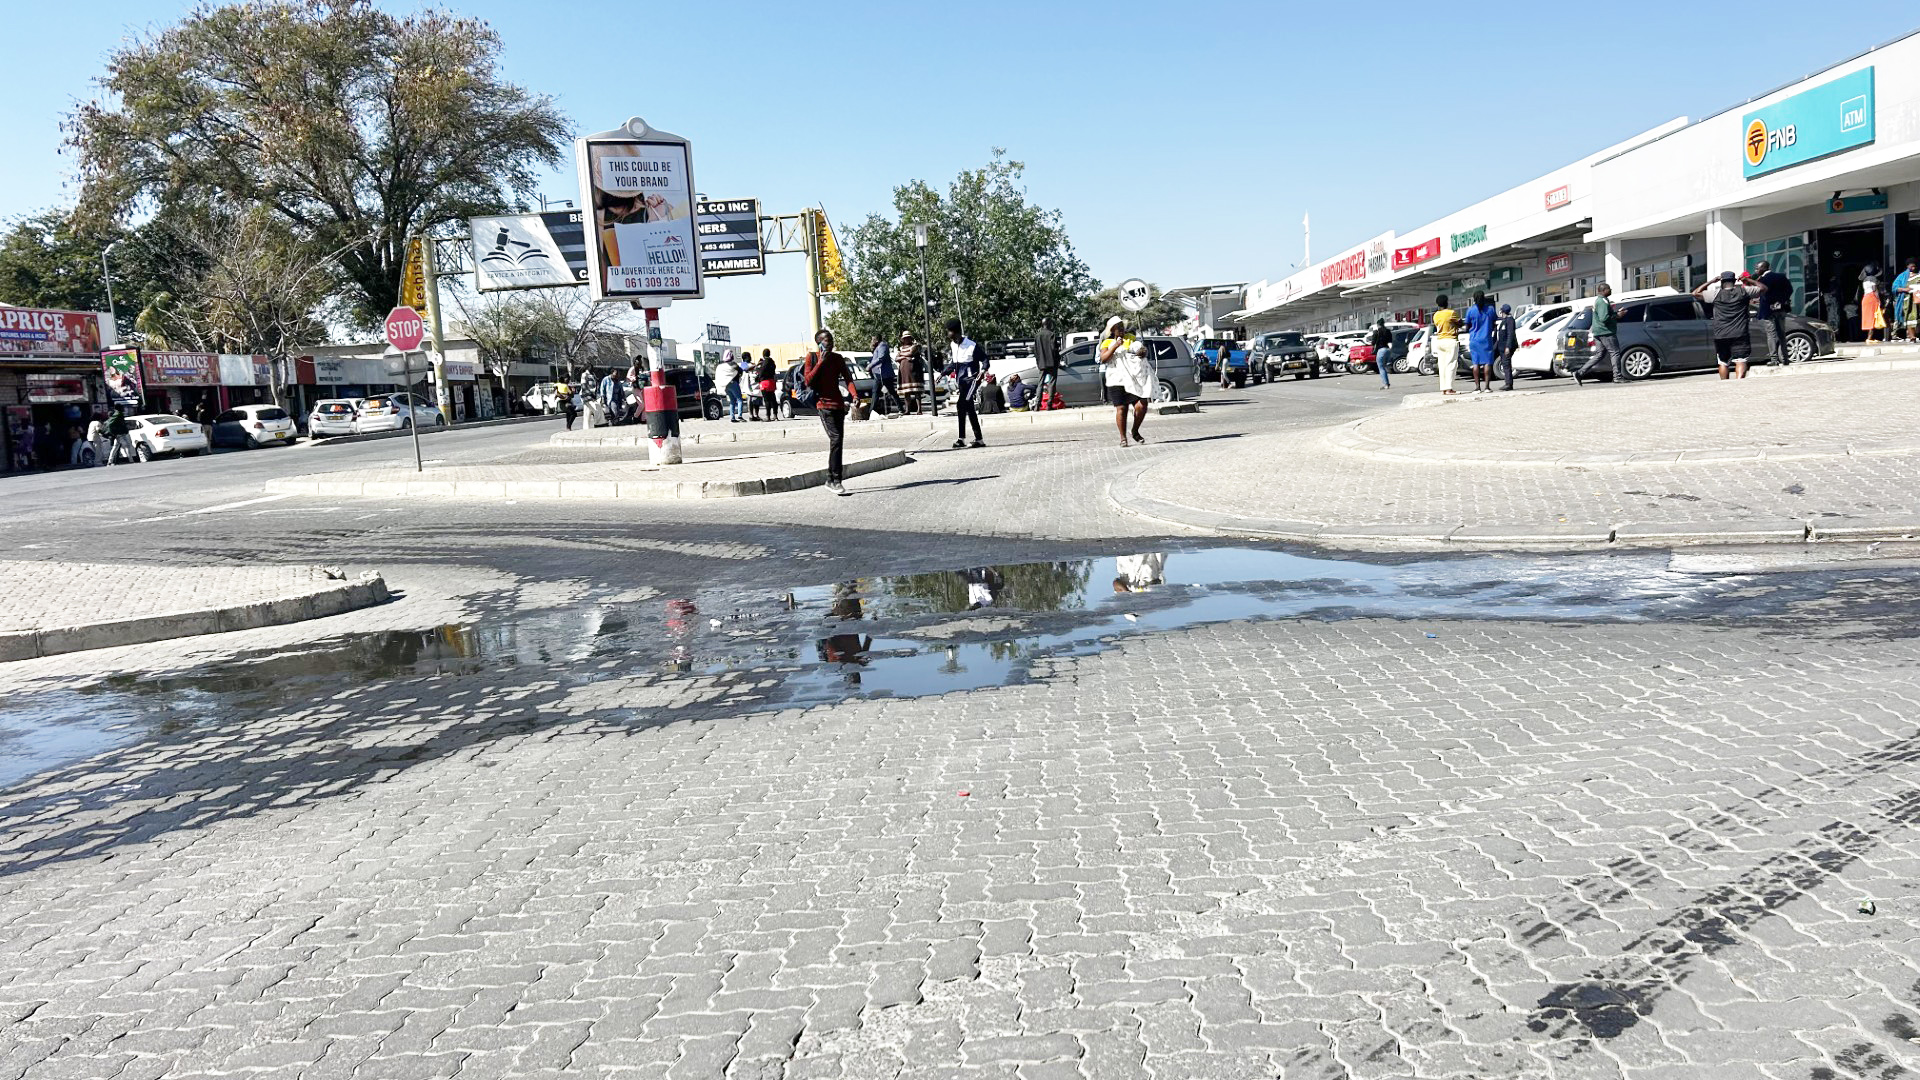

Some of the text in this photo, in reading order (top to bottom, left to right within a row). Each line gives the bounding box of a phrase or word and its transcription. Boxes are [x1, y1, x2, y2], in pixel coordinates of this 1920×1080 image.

[1844, 108, 1863, 128] ATM
[1767, 124, 1797, 152] FNB
[609, 161, 672, 172] THIS COULD BE
[615, 177, 669, 188] YOUR BRAND
[1546, 189, 1566, 206] STYLE
[697, 202, 749, 214] & CO INC
[648, 249, 688, 265] HELLO!!
[610, 266, 691, 276] TO ADVERTISE HERE CALL
[707, 259, 759, 270] HAMMER
[625, 277, 681, 288] 061 309 238
[389, 319, 420, 340] STOP
[155, 354, 209, 369] FAIRPRICE
